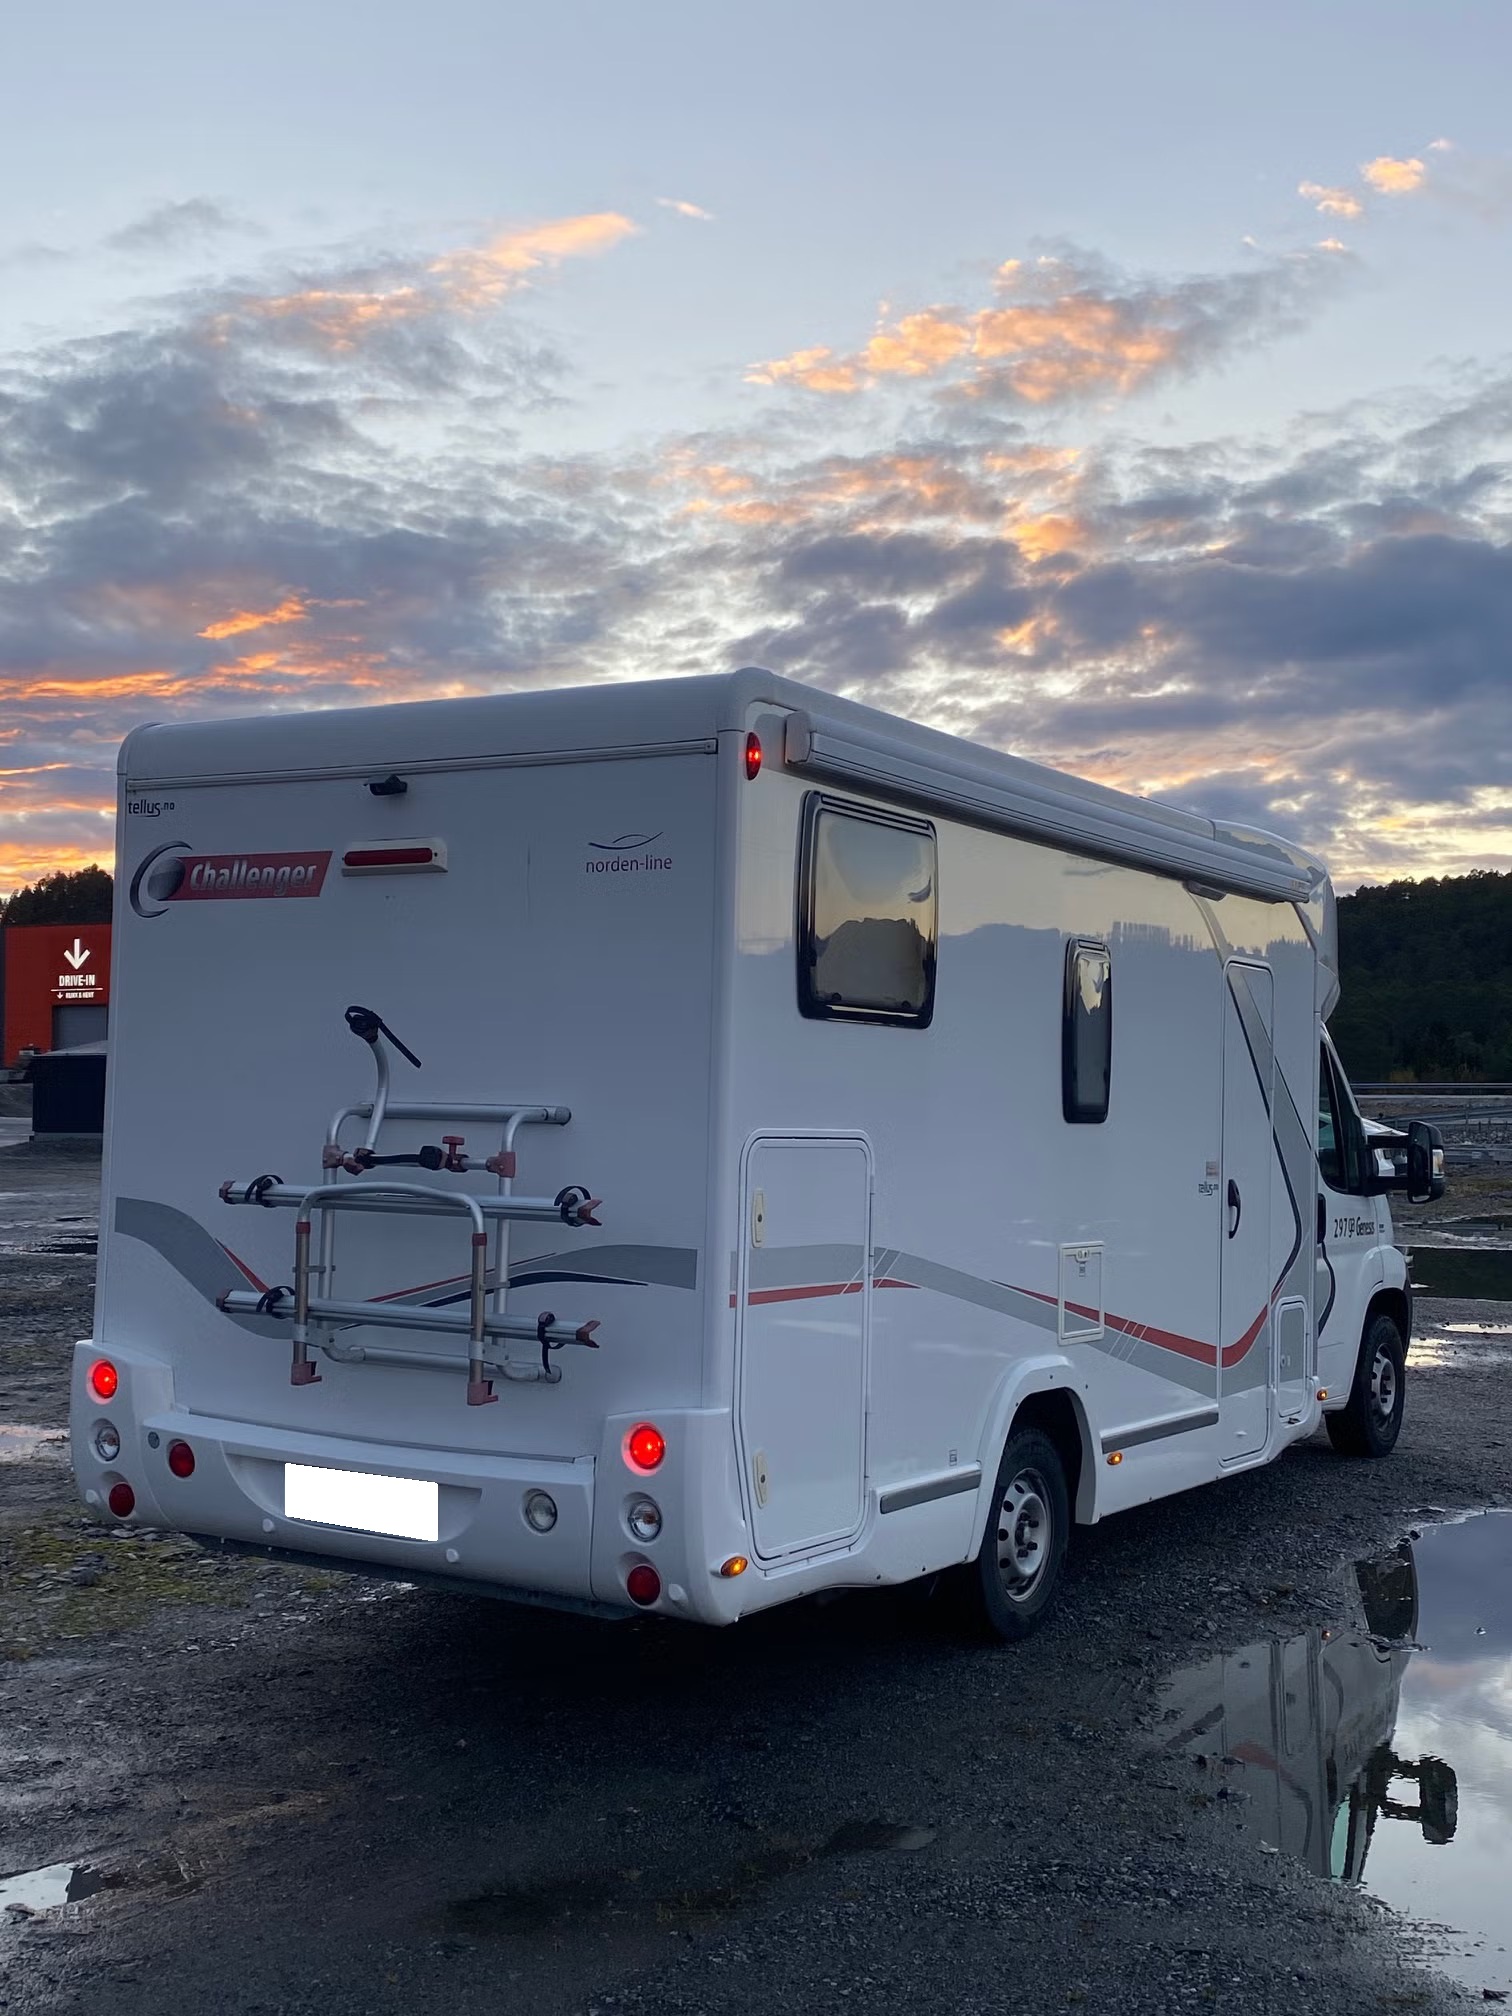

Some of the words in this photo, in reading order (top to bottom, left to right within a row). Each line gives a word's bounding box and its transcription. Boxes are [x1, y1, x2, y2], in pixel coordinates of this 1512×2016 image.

[128, 799, 175, 818] tellus.no
[586, 854, 673, 873] norden-line
[190, 860, 317, 896] Challenger
[59, 974, 96, 987] DRIVE-IN
